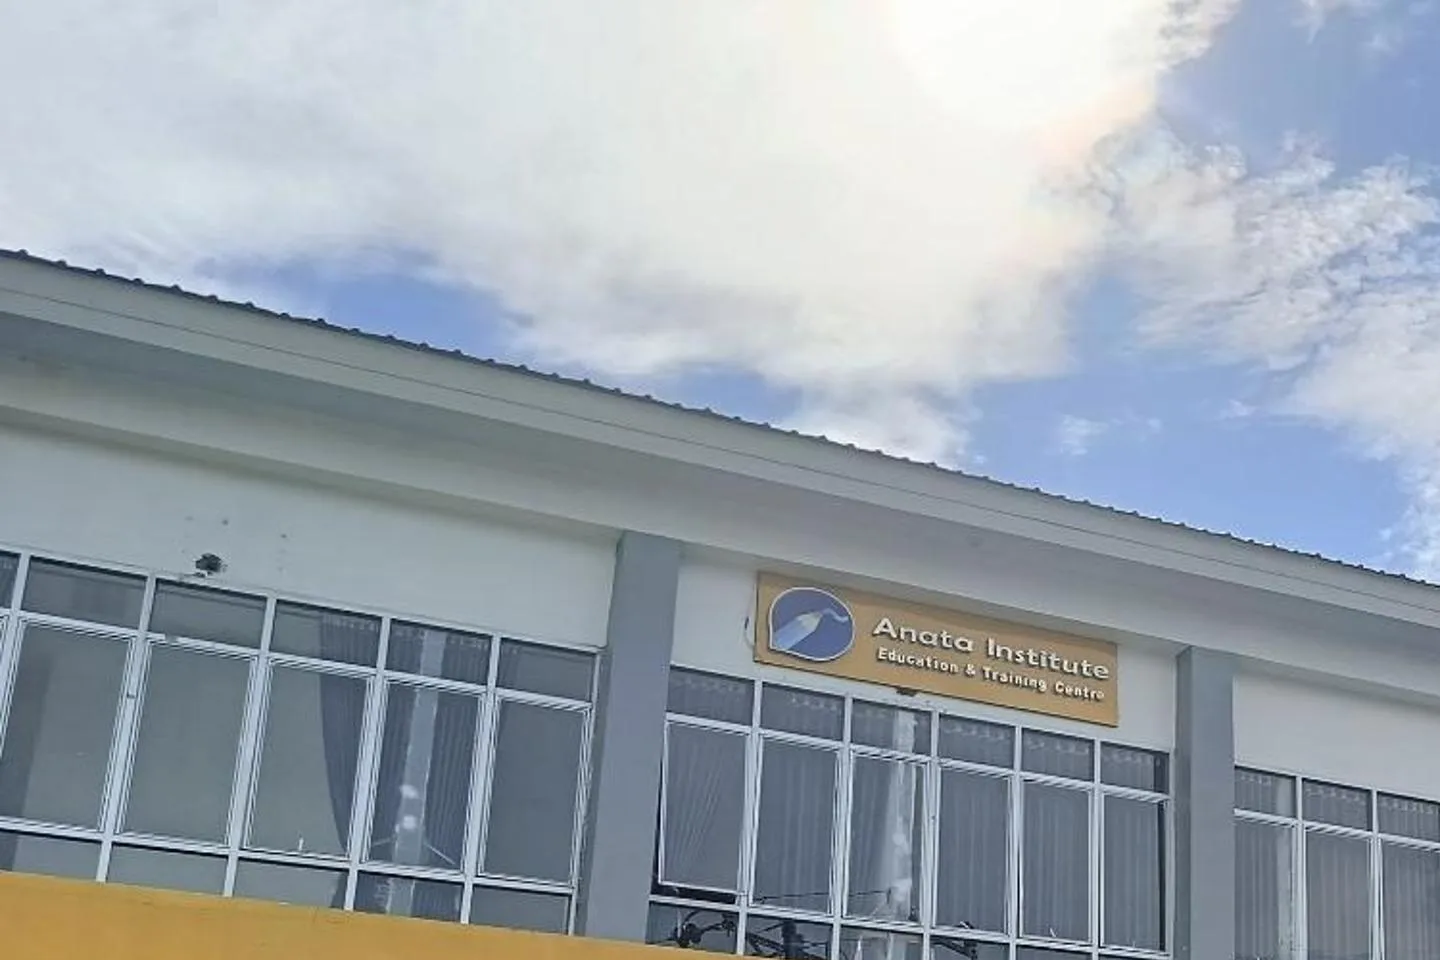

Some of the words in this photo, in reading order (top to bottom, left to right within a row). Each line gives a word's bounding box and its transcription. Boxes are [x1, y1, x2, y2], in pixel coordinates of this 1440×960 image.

[873, 617, 973, 653] Anata
[987, 637, 1110, 680] Institute
[877, 647, 959, 674] Education
[964, 663, 976, 677] &
[982, 666, 1048, 692] Training
